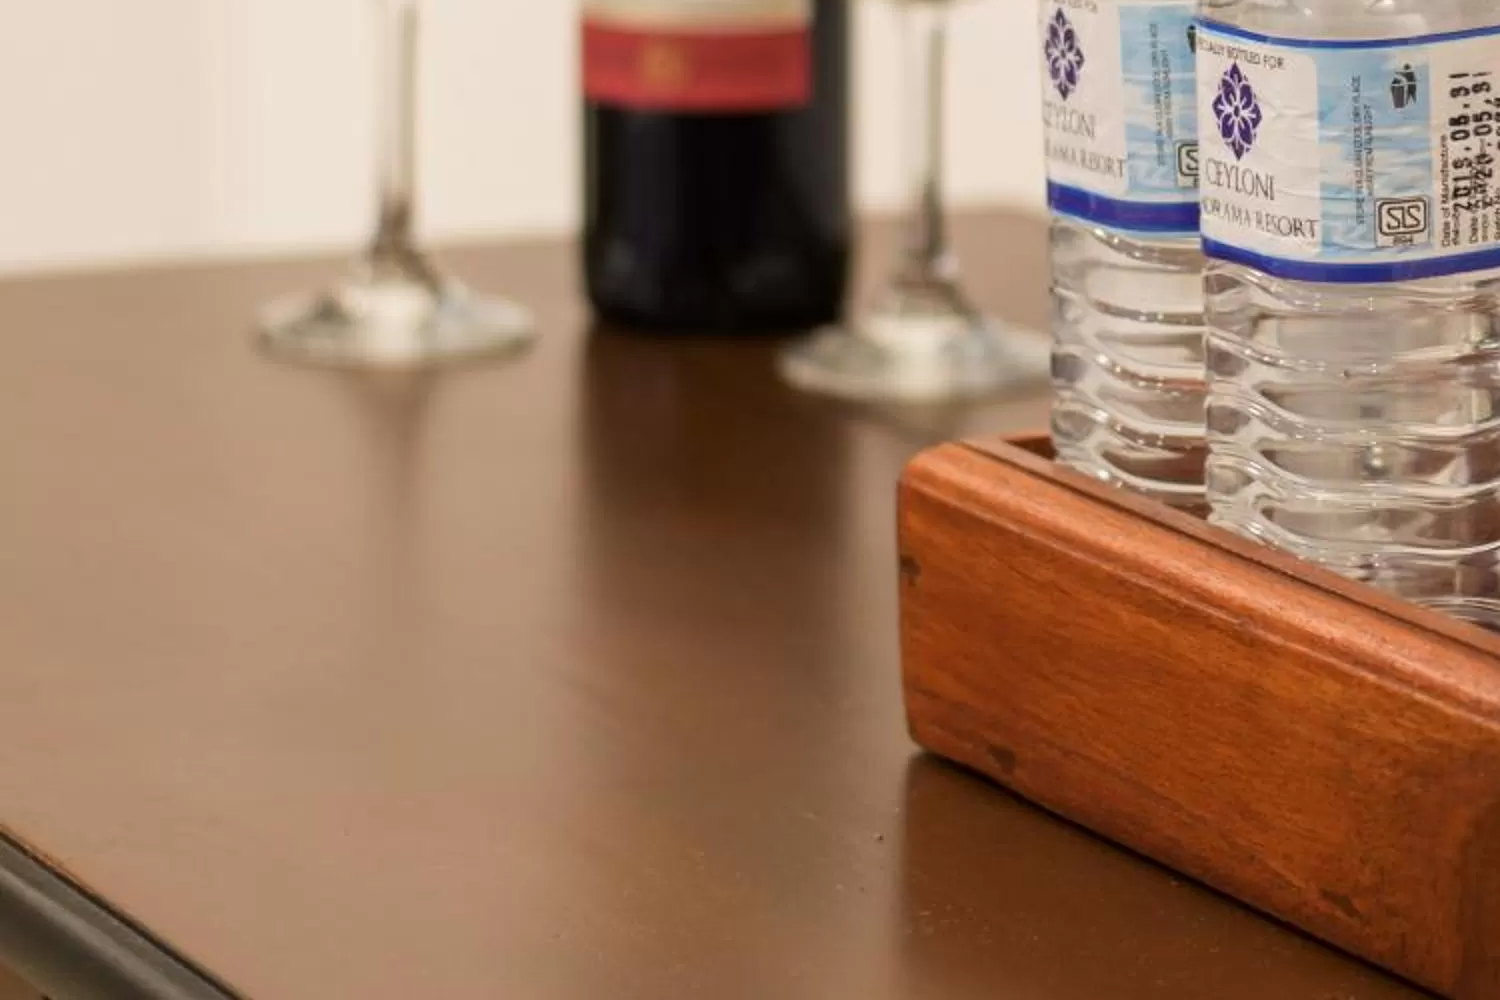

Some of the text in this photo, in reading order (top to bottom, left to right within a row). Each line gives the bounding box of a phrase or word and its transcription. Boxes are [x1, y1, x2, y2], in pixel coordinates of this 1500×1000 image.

[1206, 157, 1275, 201] CEYLONI
[1439, 134, 1449, 205] Manufacture
[1254, 210, 1321, 239] RESORT
[1441, 220, 1450, 248] Date
[1469, 215, 1478, 244] Date
